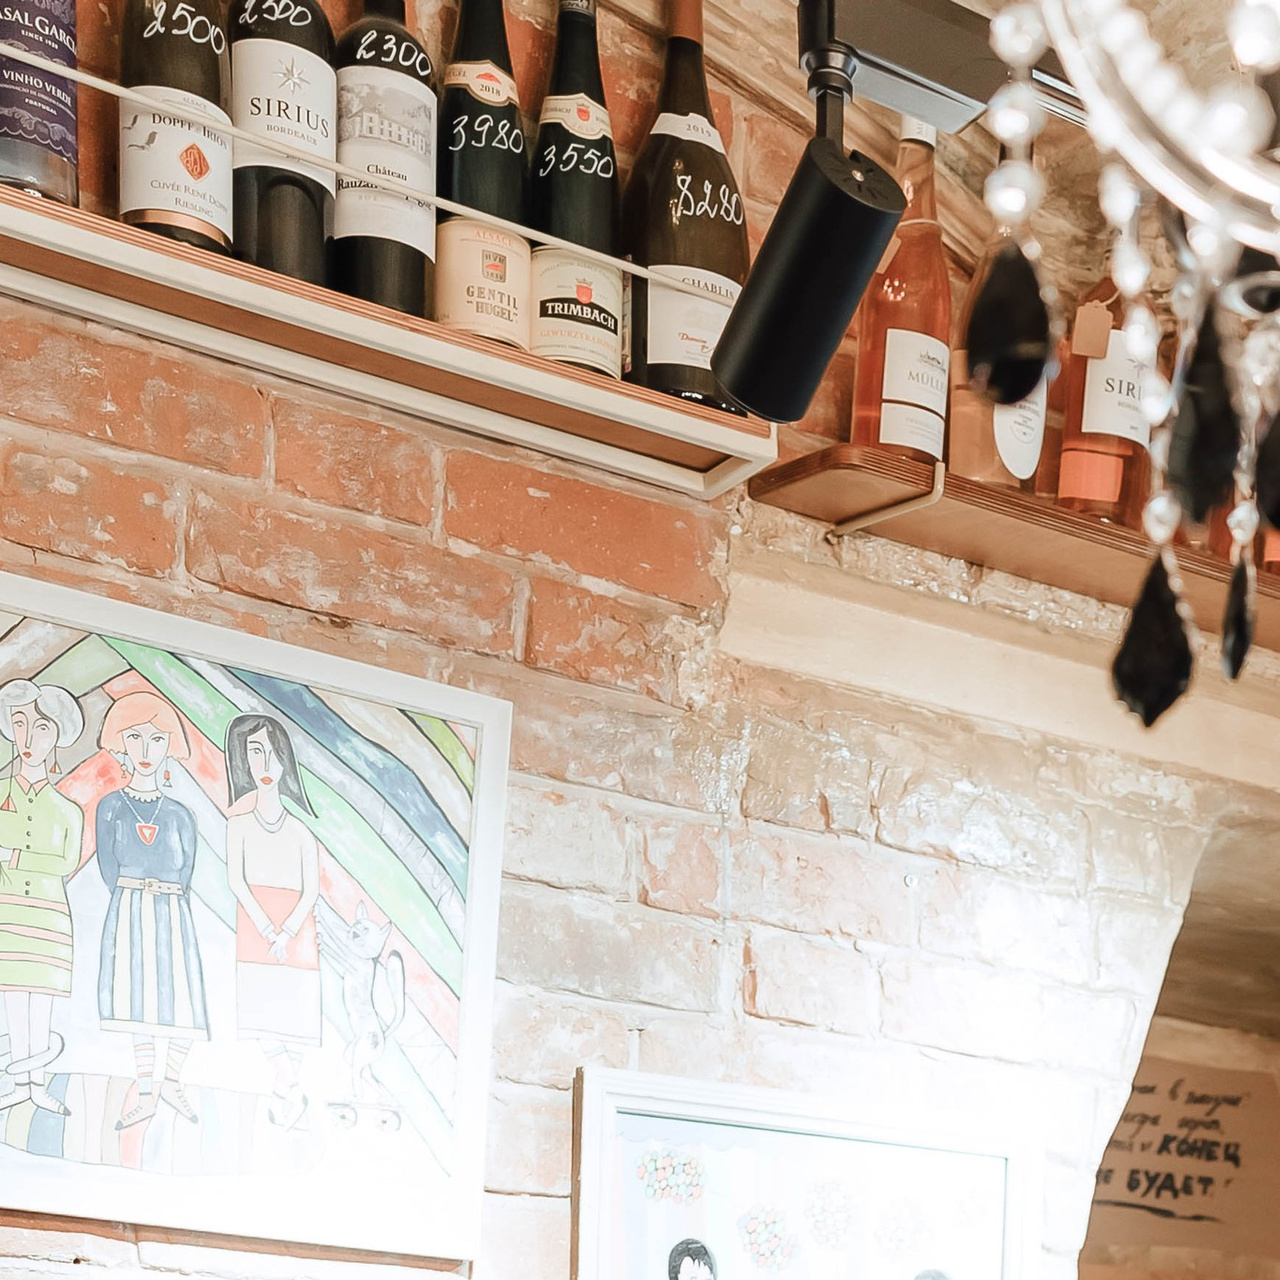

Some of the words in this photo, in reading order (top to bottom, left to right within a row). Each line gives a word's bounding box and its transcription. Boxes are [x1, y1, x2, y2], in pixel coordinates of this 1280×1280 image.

[143, 0, 226, 55] 2500
[356, 30, 432, 77] 2300
[3, 69, 43, 89] VINHO
[479, 83, 501, 97] 2018
[250, 97, 329, 139] SIRIUS
[266, 124, 318, 146] BORDEAUX
[448, 114, 524, 154] 3980
[366, 164, 408, 182] Château
[539, 143, 614, 178] 3550
[150, 179, 182, 193] CUVÉE
[676, 175, 744, 225] 8280
[174, 197, 214, 218] RIESLING
[466, 285, 518, 310] GENTIL
[546, 302, 616, 330] TRIMBACH
[1157, 1133, 1242, 1168] КОНЕЦ
